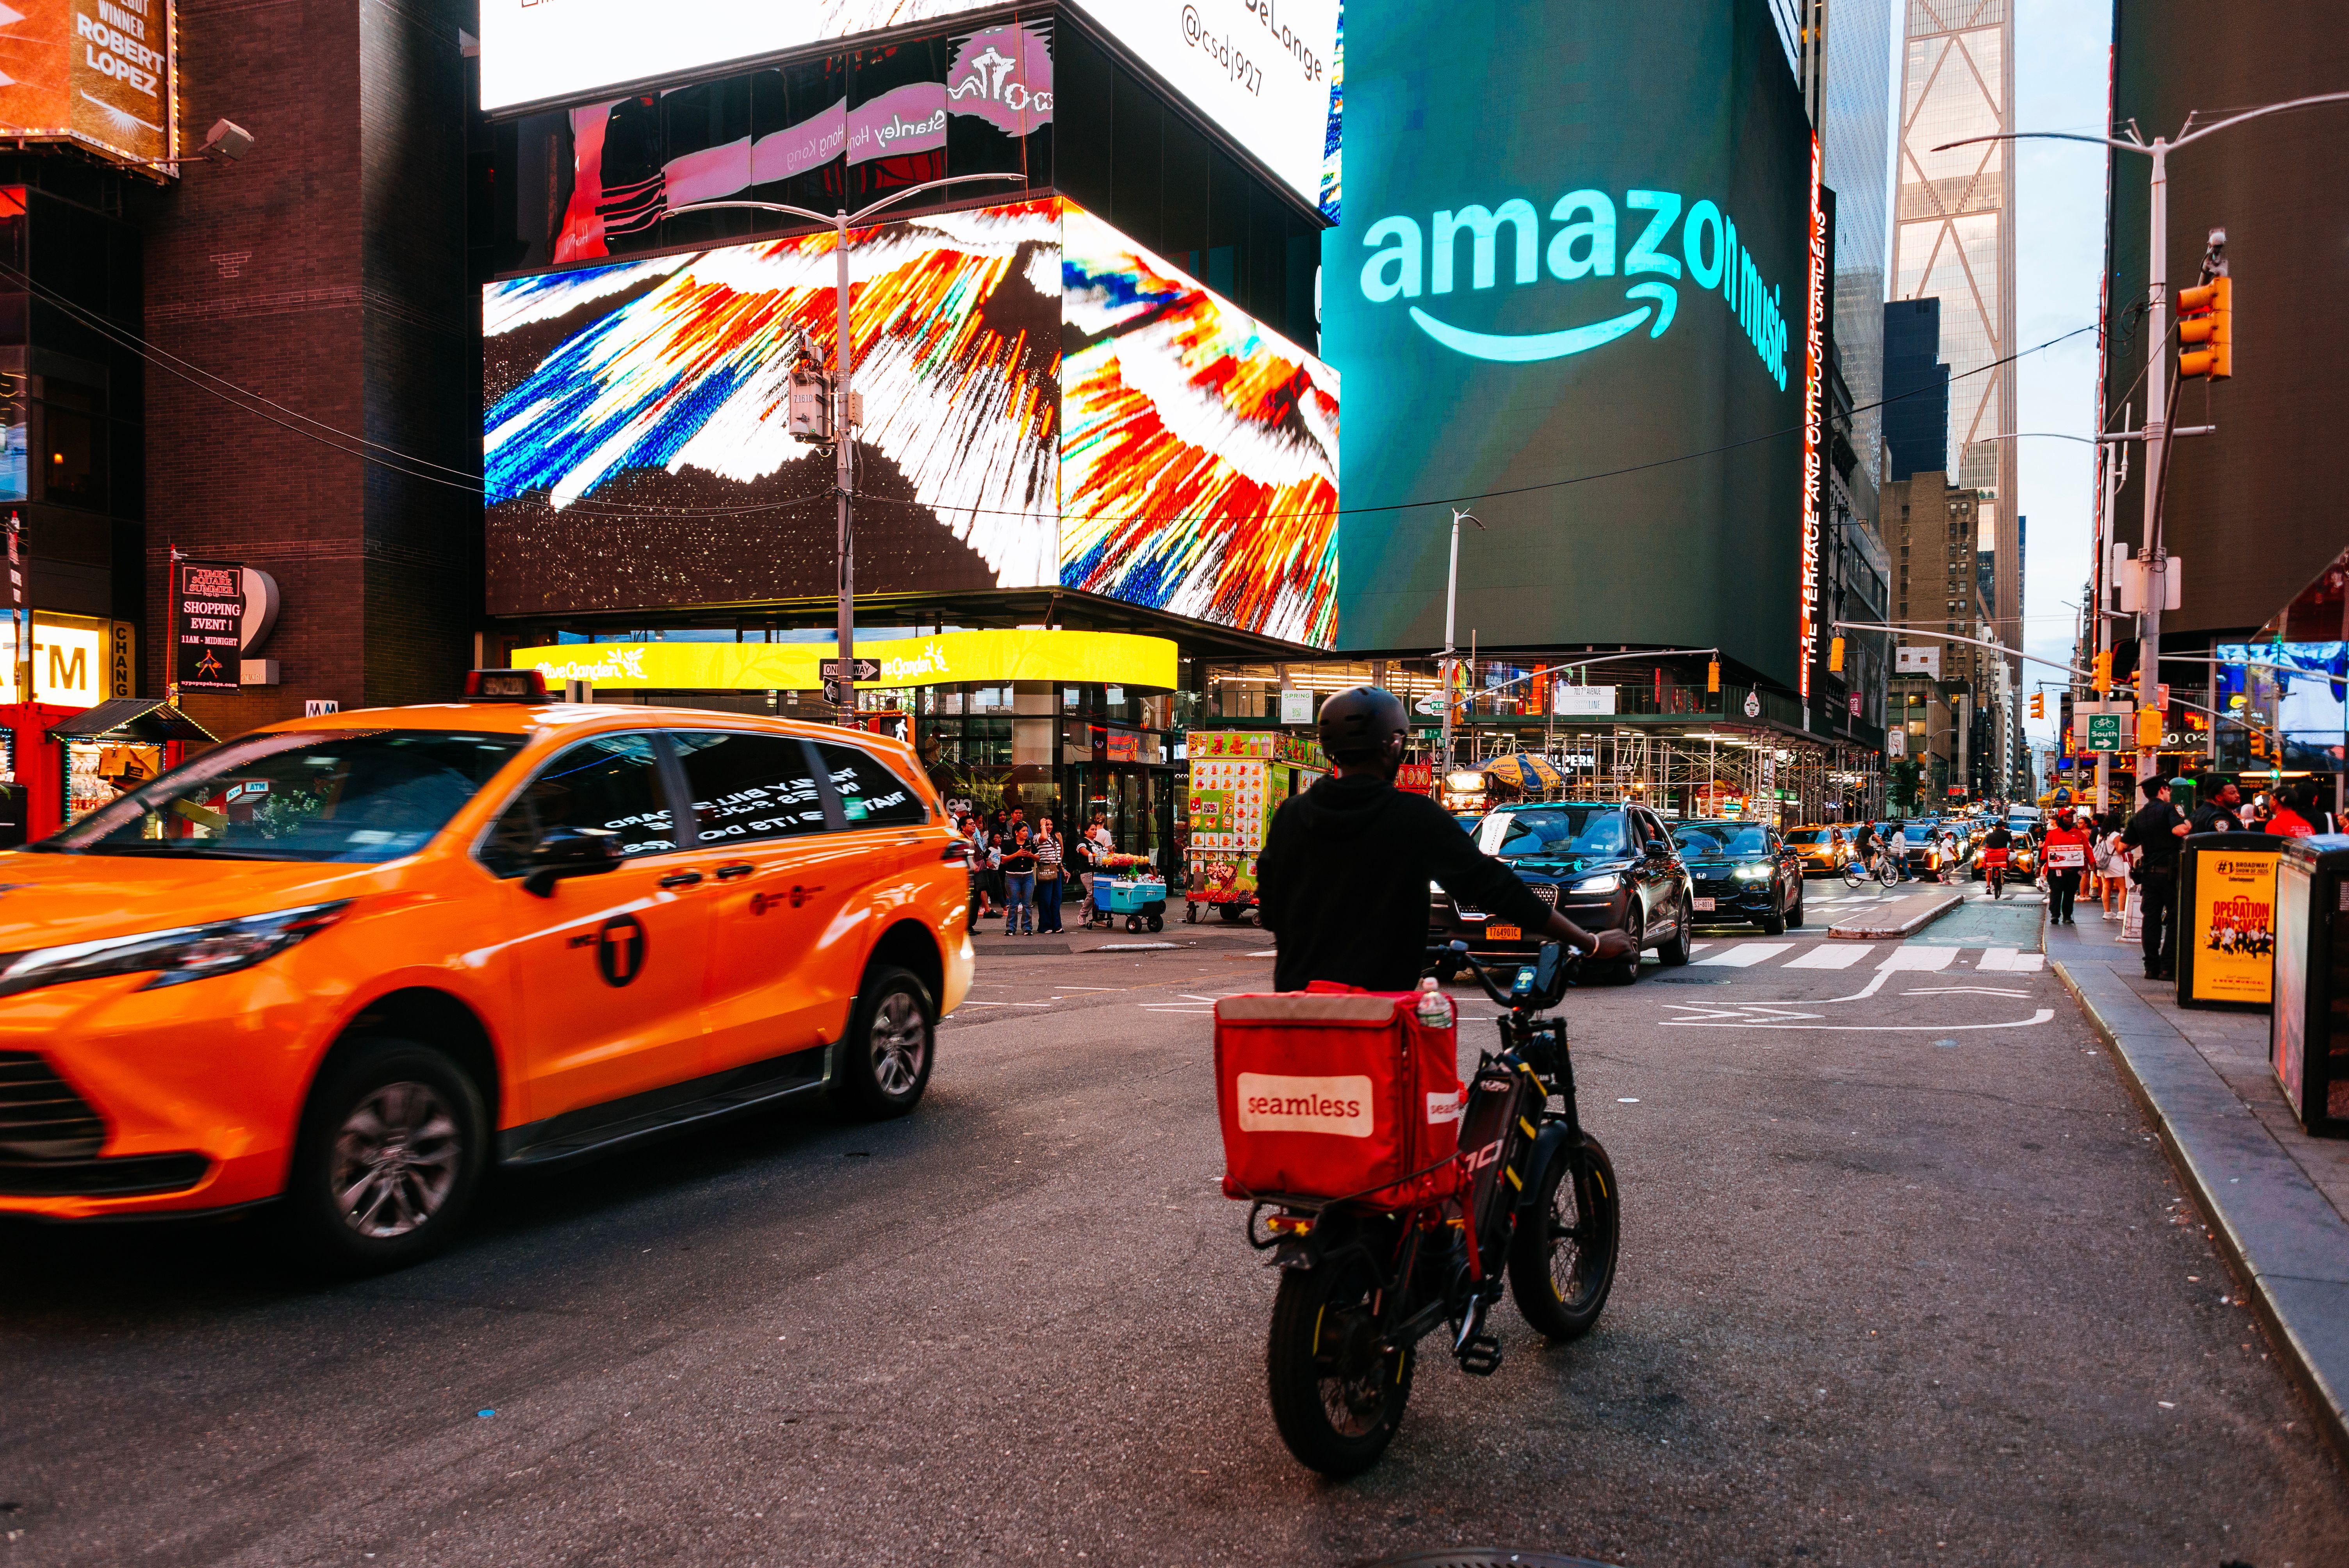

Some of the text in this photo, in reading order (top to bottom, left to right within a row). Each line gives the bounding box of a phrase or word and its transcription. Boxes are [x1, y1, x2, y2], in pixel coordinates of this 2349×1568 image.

[98, 0, 145, 41] WINNER
[78, 12, 165, 75] ROBERT
[1182, 4, 1262, 96] @csdj927
[86, 44, 157, 98] LOPEZ
[1360, 189, 1787, 392] amazon music
[1808, 212, 1826, 663] THE TERRACE AND OUTDOOR GARDENS
[192, 576, 232, 586] SQUARE
[197, 569, 228, 578] TIMES
[189, 584, 233, 594] SUMMER
[184, 601, 241, 616] SHOPPING
[191, 618, 233, 631] EVENT !
[181, 635, 199, 644] 11AM
[205, 637, 238, 646] MIDNIGHT
[0, 642, 86, 691] TM
[115, 627, 128, 697] CHANG
[825, 665, 838, 675] ON
[853, 665, 870, 675] WAY
[893, 655, 934, 680] Garden
[566, 660, 622, 681] Garden
[1431, 693, 1445, 701] CENTR
[1574, 700, 1600, 709] SKYLINE
[1562, 755, 1595, 766] PERK
[229, 788, 241, 798] ATM
[2217, 861, 2233, 873] #1
[2213, 901, 2269, 918] OPERATION
[1490, 928, 1518, 937] T764901C
[2213, 916, 2269, 934] MINEMEAT
[1248, 1094, 1361, 1118] seamless
